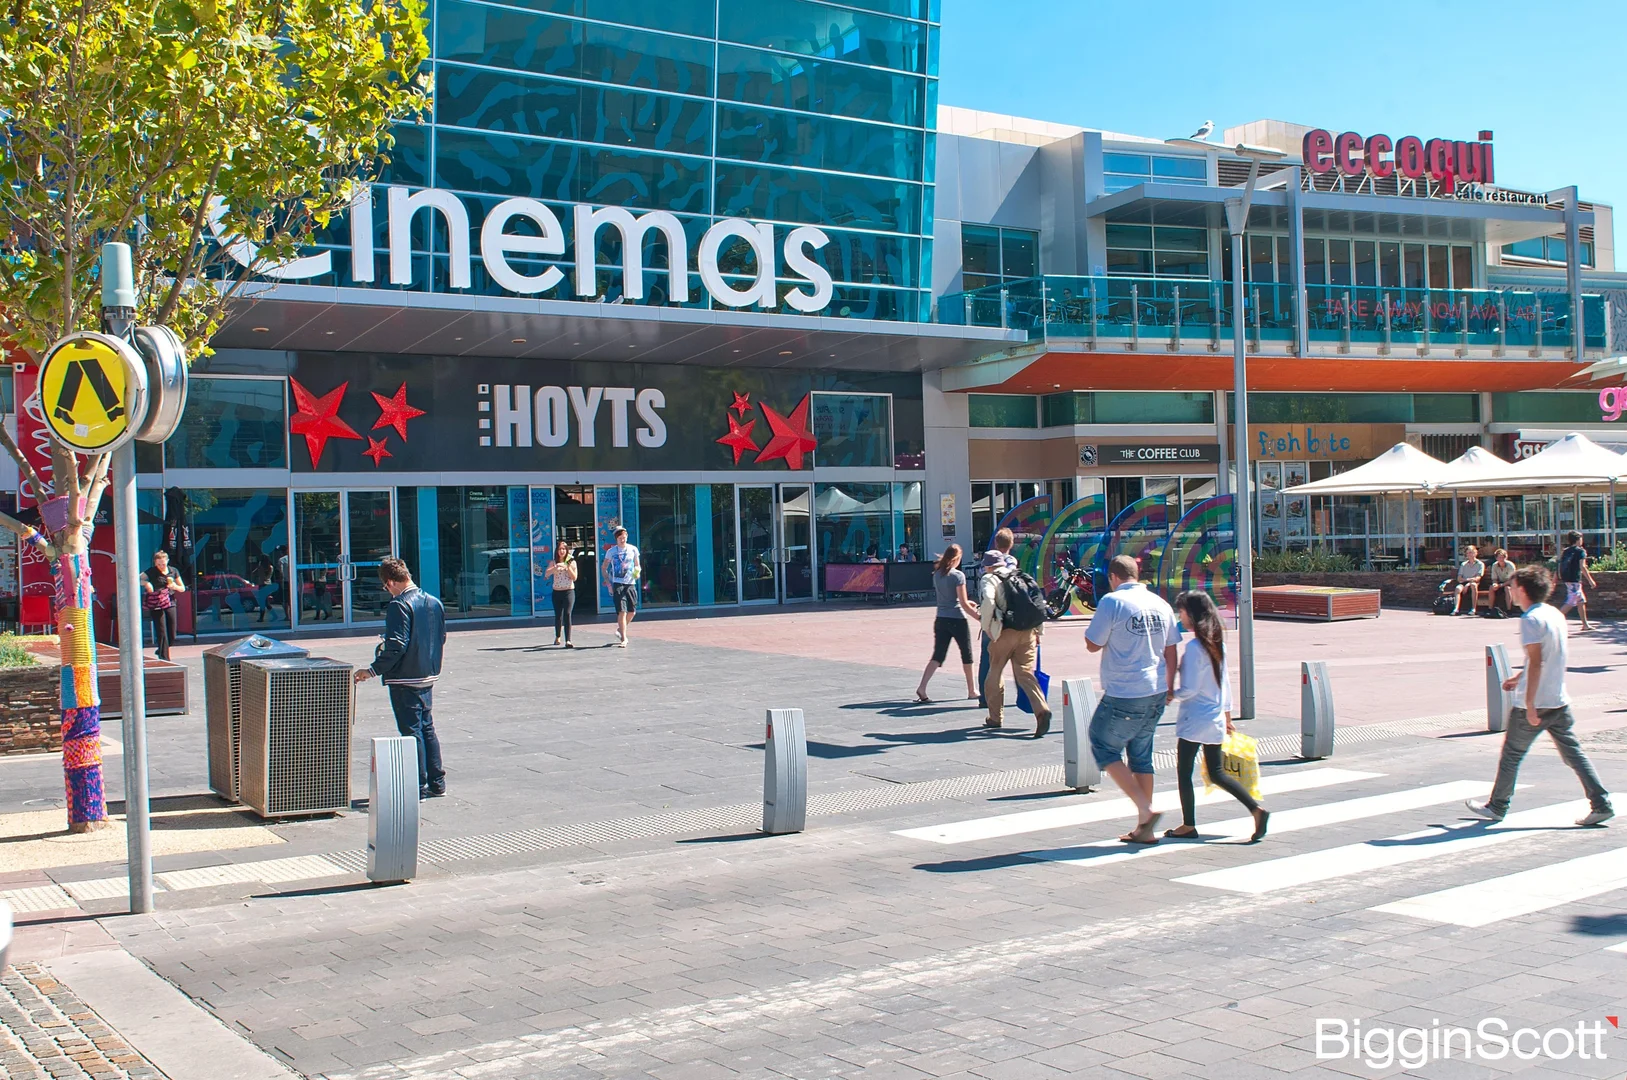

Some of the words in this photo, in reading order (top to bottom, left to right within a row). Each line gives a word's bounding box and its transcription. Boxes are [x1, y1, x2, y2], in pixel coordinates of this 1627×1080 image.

[1302, 129, 1494, 194] eccoqui
[1485, 192, 1549, 205] restaurant
[1324, 299, 1368, 317] TAKE
[1428, 303, 1462, 319] NOW
[494, 384, 667, 448] HOYTS
[1120, 449, 1136, 458] THE
[1138, 447, 1178, 459] COFFEE
[1179, 449, 1201, 458] CLUB
